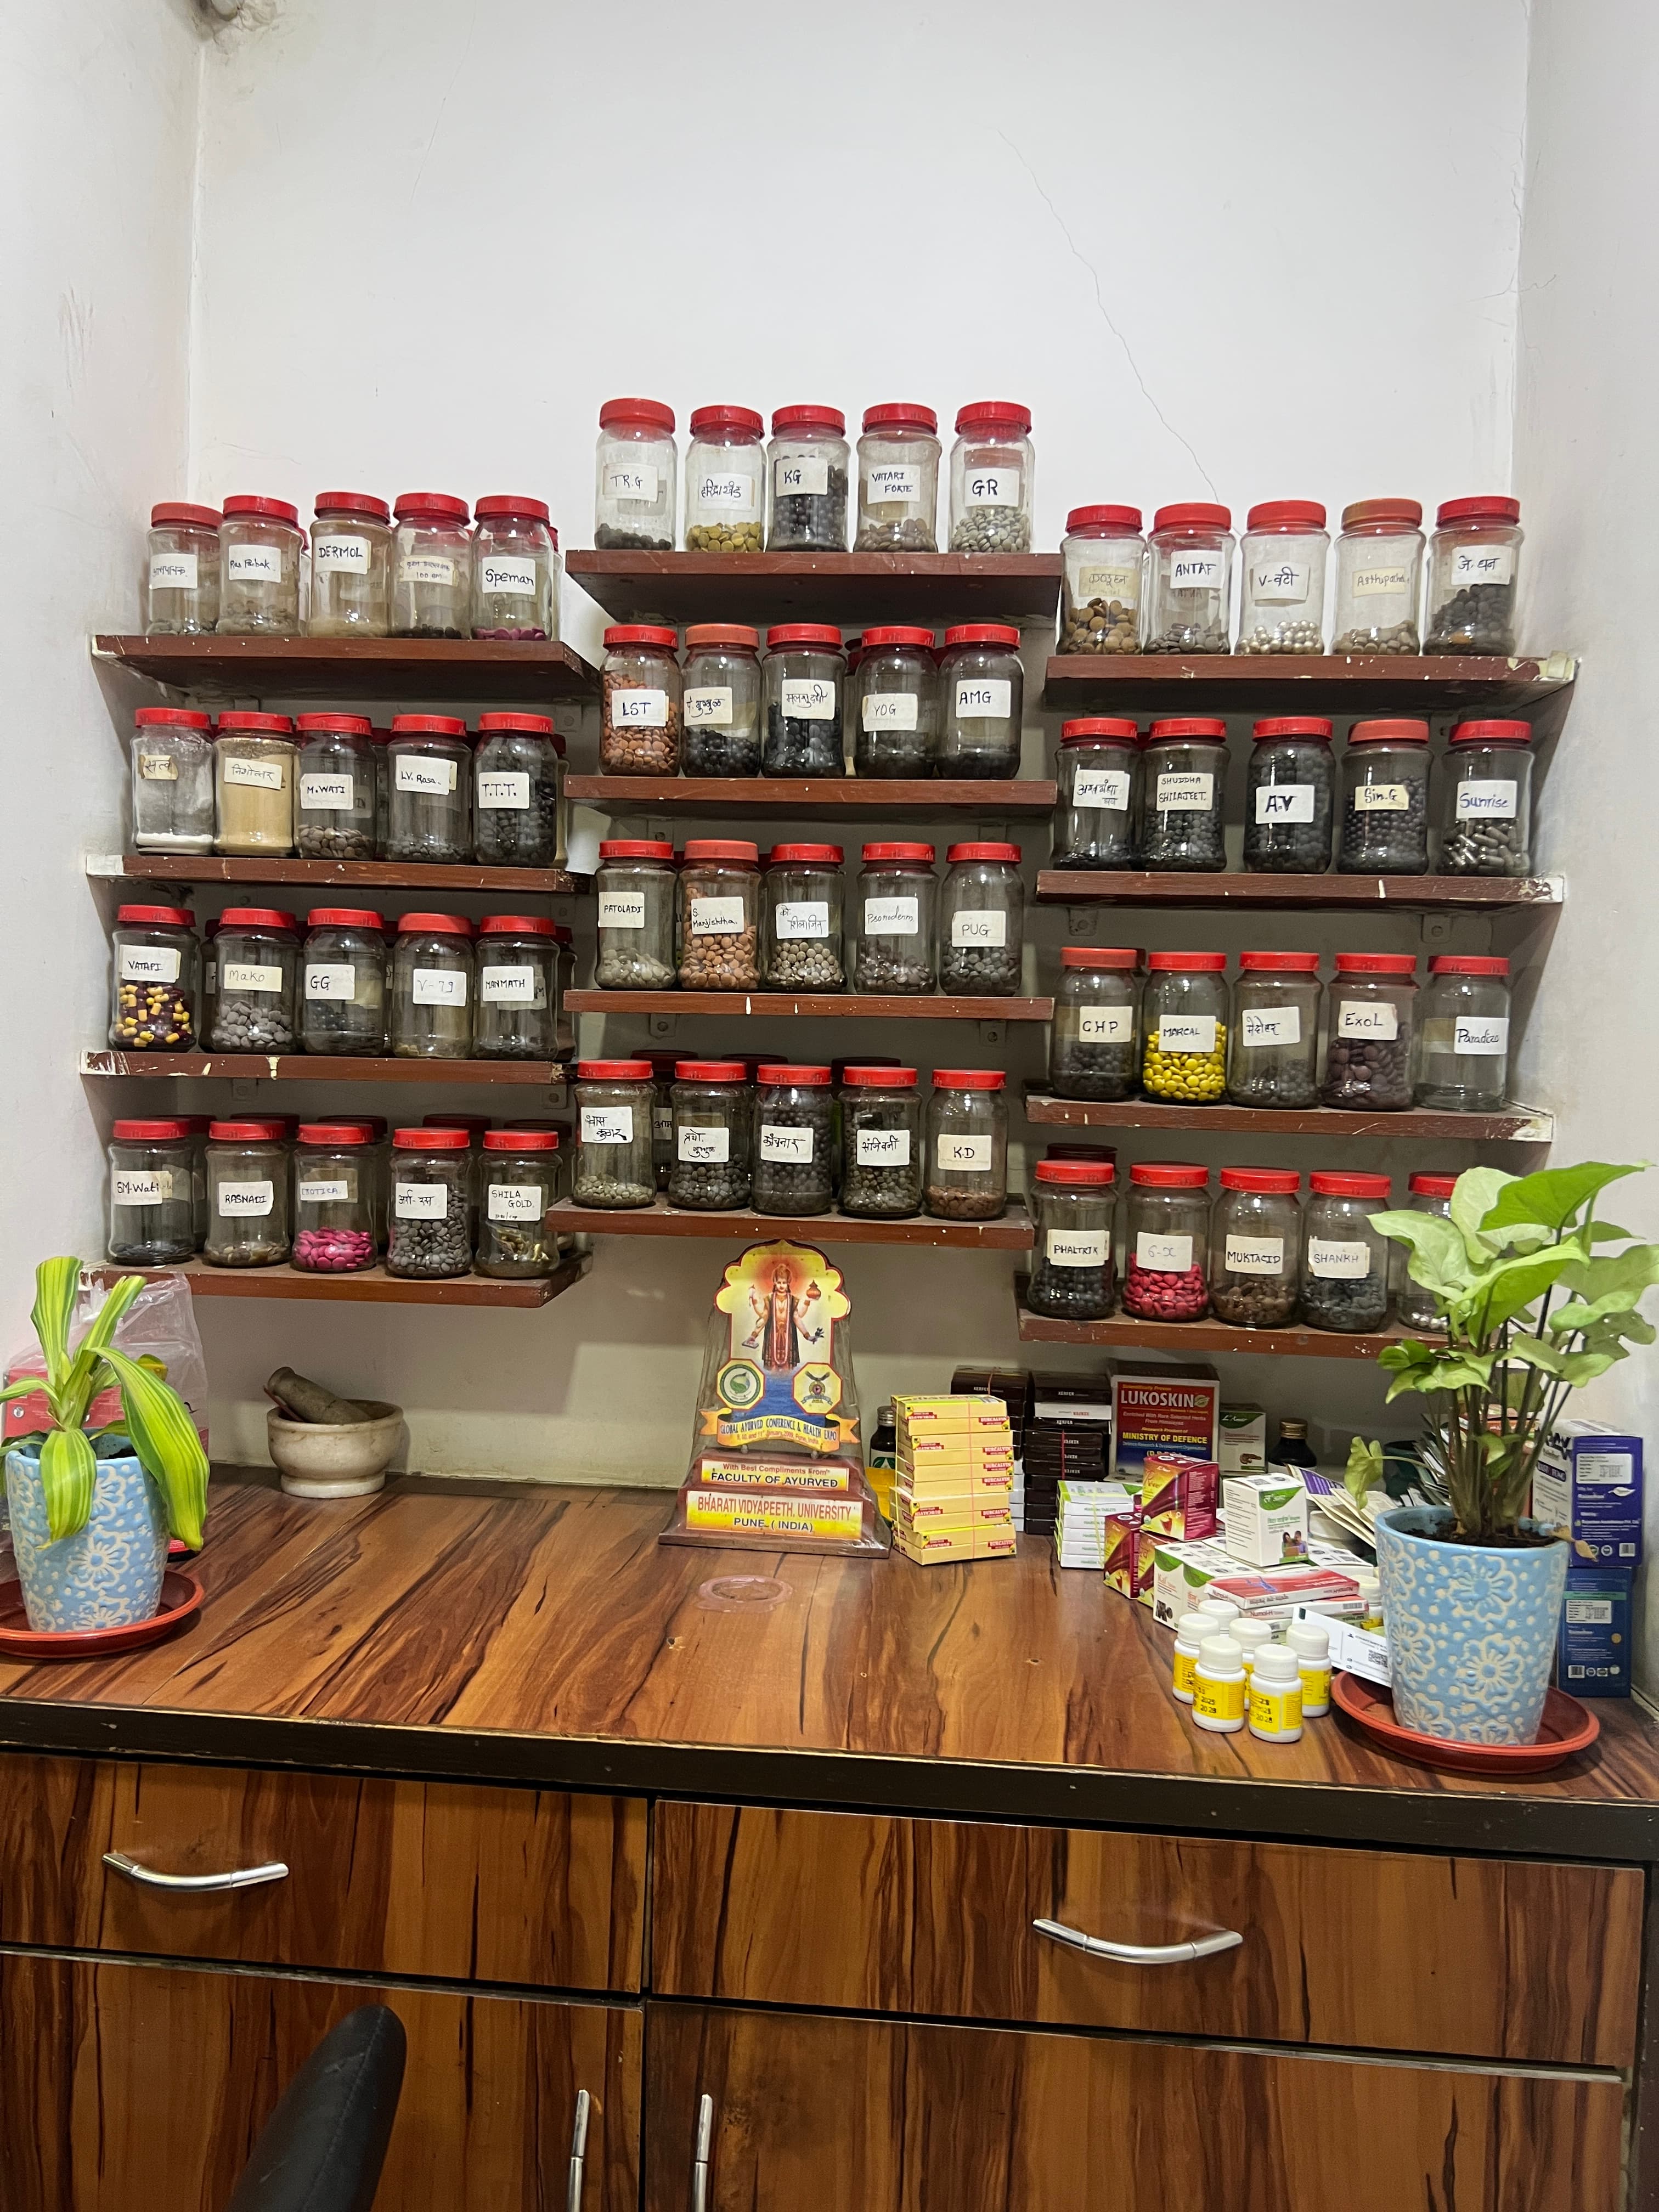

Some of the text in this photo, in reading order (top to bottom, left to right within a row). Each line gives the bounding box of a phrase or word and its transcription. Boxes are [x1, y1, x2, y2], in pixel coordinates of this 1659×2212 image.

[784, 470, 801, 484] KG
[872, 472, 905, 482] VATARI
[885, 484, 913, 493] FORTE
[972, 479, 998, 496] GR
[319, 546, 363, 558] DERMOL
[1176, 563, 1216, 577] ANTAF
[486, 568, 534, 586] Speman
[960, 691, 991, 704] AMG
[622, 702, 651, 716] LST
[874, 704, 896, 716] YOG
[1460, 793, 1509, 808] Sunrise
[962, 924, 991, 937] PUG
[229, 970, 264, 982] Mako
[310, 975, 330, 991] GG
[486, 979, 525, 989] MANMATH
[225, 1195, 267, 1203] RASNADI
[492, 1190, 521, 1198] SHILA
[1227, 1252, 1280, 1263] MUKTACID
[1314, 1254, 1358, 1263] SHANKH
[1121, 1390, 1194, 1408] LUKOSKIN
[720, 1424, 738, 1434] GLOBAL
[742, 1419, 763, 1431] AYURVED
[766, 1418, 795, 1430] CONFERENCE
[803, 1424, 821, 1437] HEALTH
[825, 1430, 837, 1441] EXPO
[1122, 1432, 1159, 1441] MINISTRY
[1173, 1435, 1207, 1444] DEFENCE
[759, 1465, 805, 1475] Compliments
[712, 1472, 838, 1487] FACULTY OF AYURVED
[698, 1496, 736, 1513] BHARATI
[798, 1503, 851, 1520] UNIVERSITY
